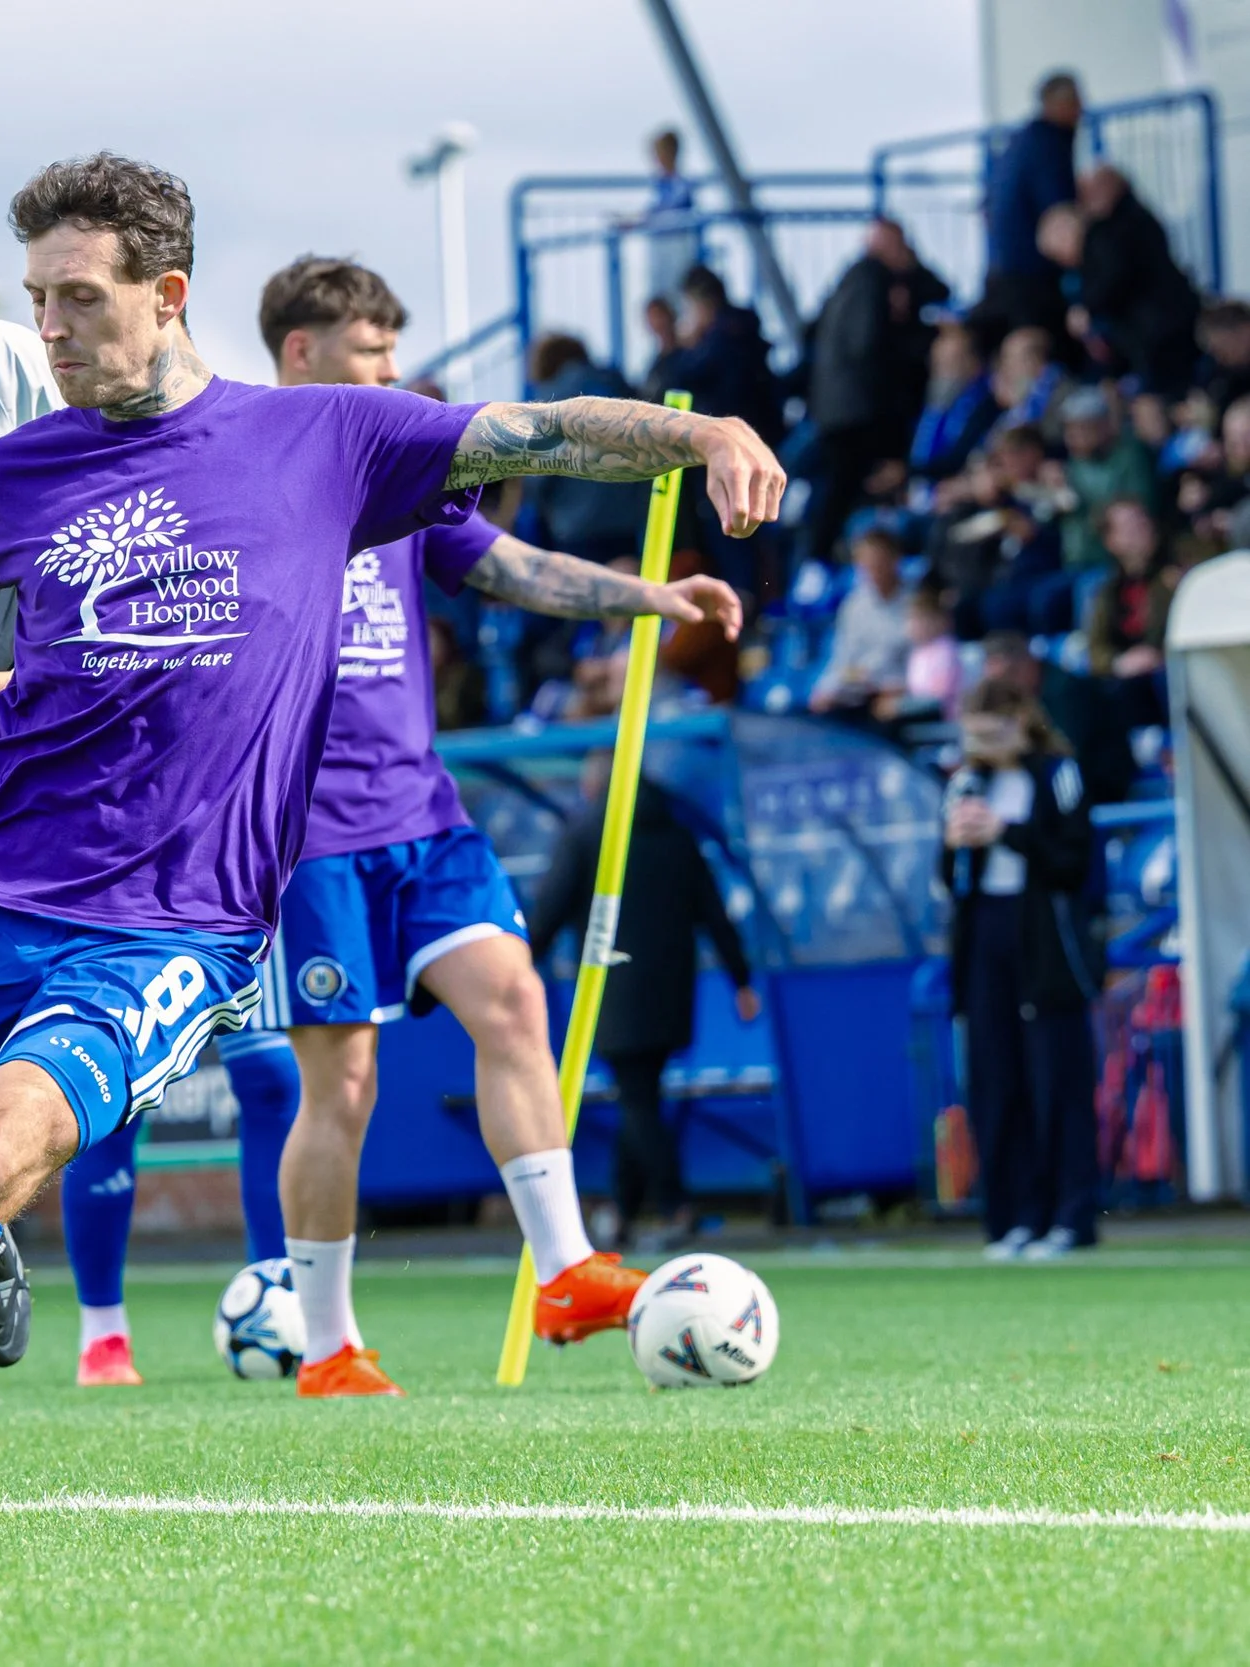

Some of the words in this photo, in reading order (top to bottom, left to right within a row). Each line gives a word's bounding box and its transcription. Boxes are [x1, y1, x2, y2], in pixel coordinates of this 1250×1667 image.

[134, 544, 240, 577] Willow
[151, 565, 240, 601] Wood
[128, 597, 240, 634] Hospice
[82, 651, 158, 677] Together
[191, 652, 233, 666] care
[142, 955, 205, 1026] 8
